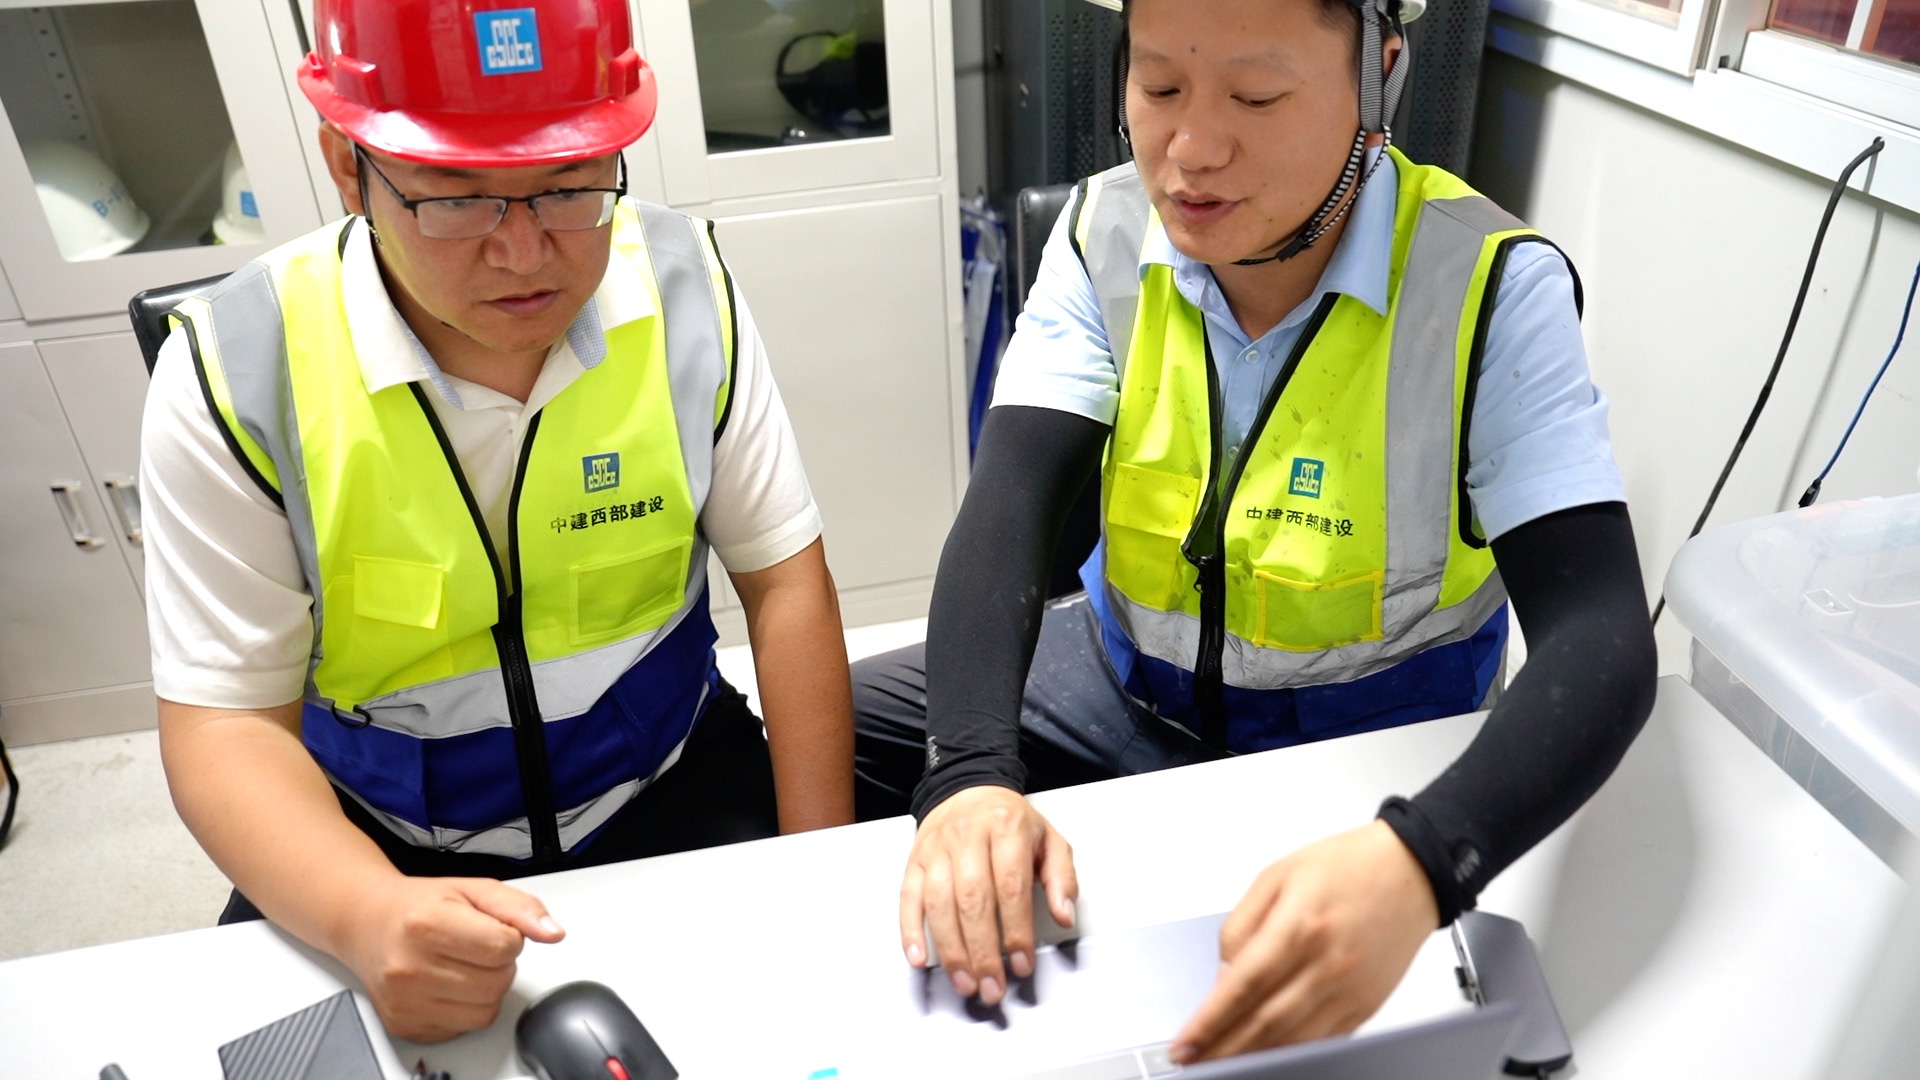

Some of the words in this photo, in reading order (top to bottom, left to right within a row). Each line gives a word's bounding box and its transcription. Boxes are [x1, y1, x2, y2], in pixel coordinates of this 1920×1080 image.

[550, 496, 664, 534] 中建西部建设
